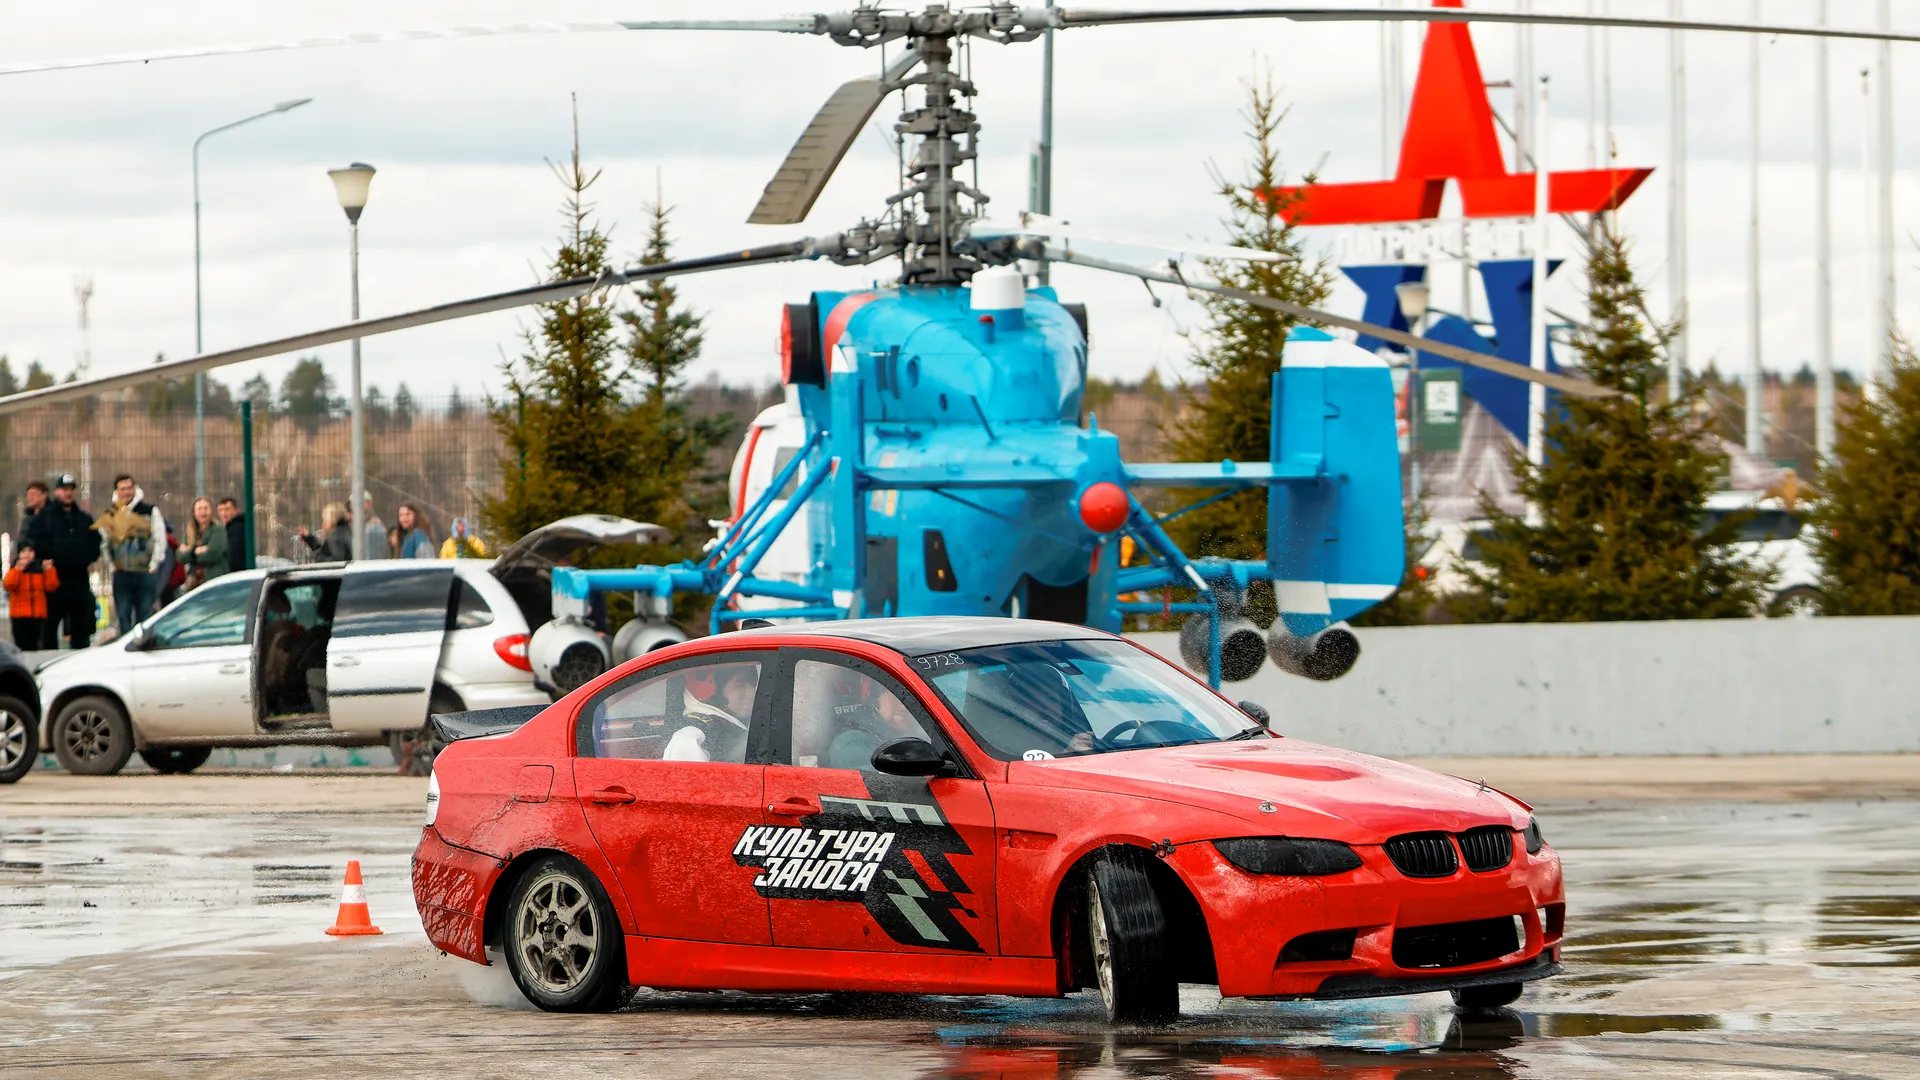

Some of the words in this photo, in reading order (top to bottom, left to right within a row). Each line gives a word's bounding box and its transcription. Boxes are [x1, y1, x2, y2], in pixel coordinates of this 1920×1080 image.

[917, 653, 965, 670] 9728
[733, 826, 895, 862] КУЛЬТУРА
[753, 857, 881, 892] ЗАНОСА
